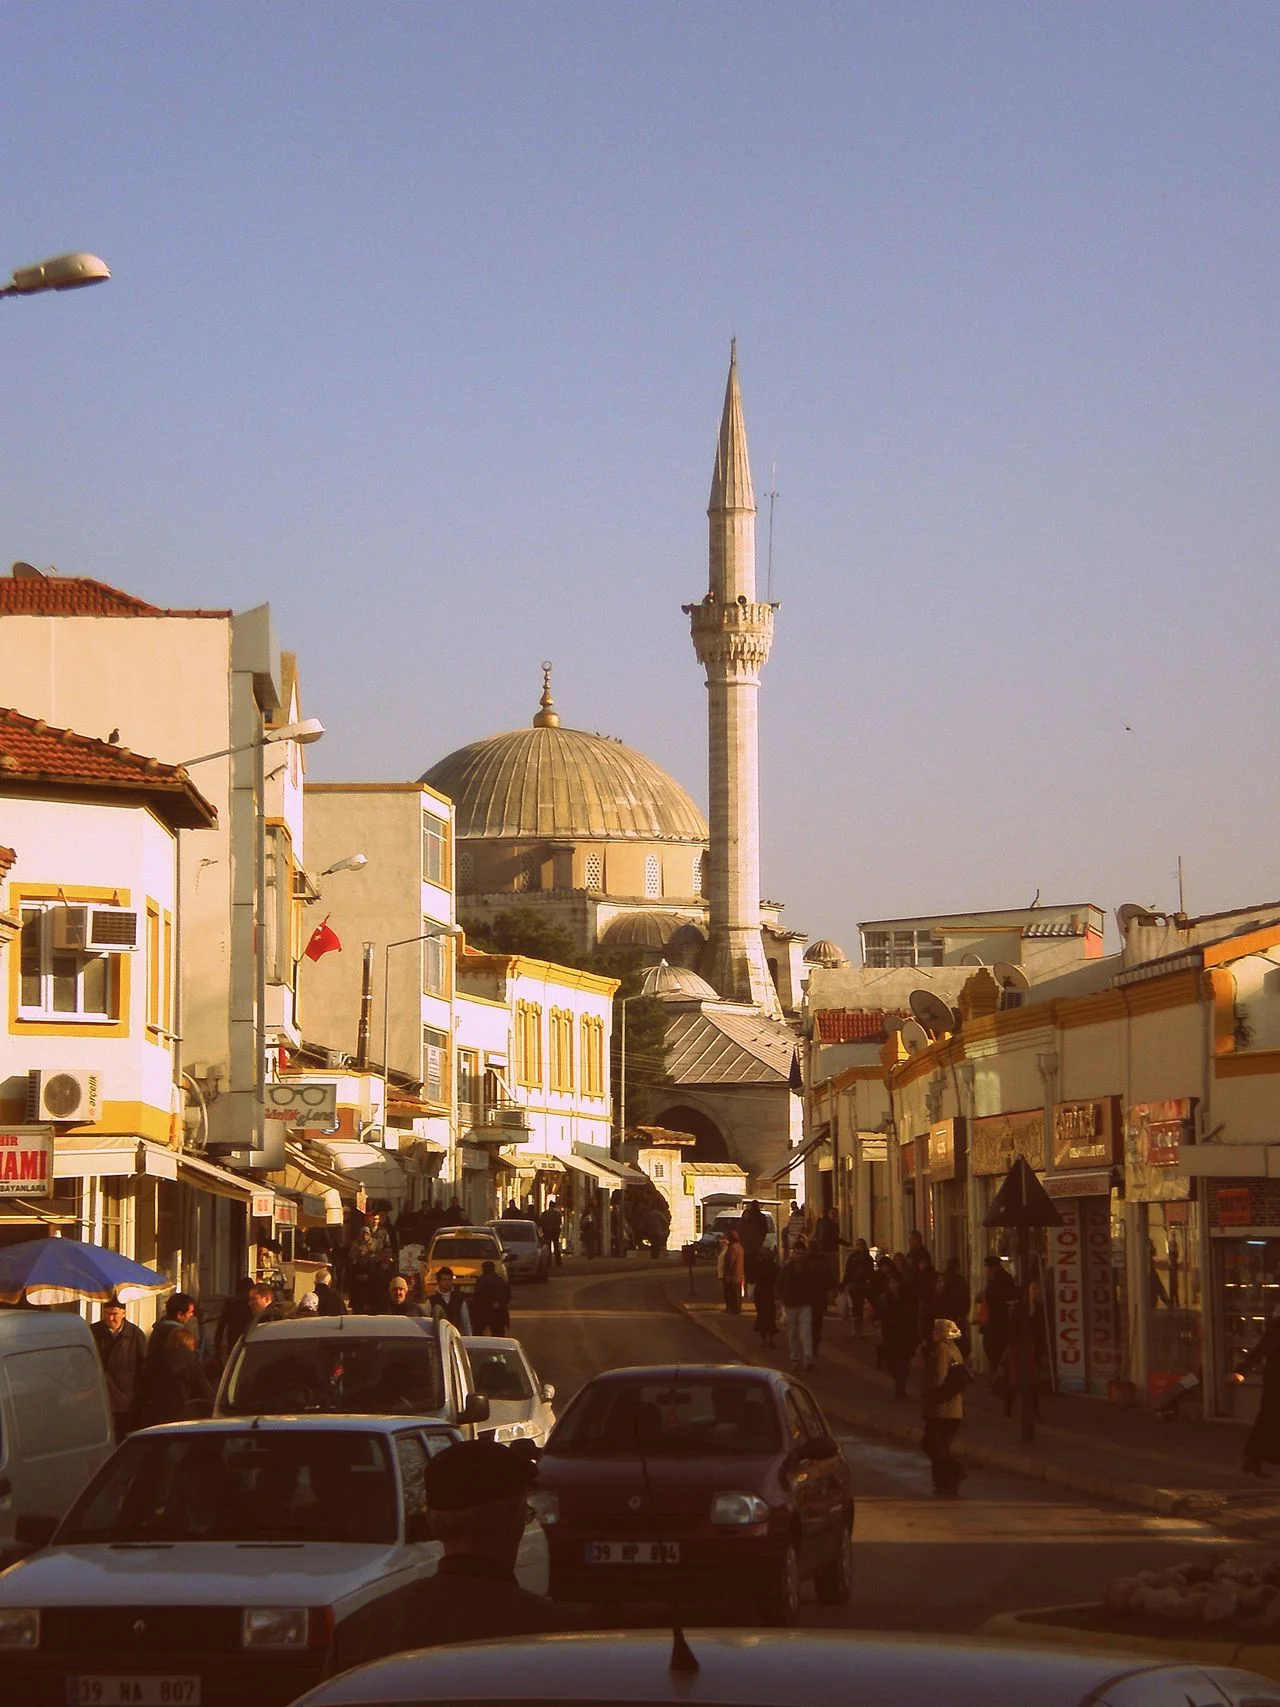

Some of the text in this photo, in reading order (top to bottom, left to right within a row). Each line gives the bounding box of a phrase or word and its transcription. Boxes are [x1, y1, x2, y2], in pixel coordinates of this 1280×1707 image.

[87, 1076, 98, 1107] arçelik
[0, 1150, 48, 1180] AMI
[1056, 1212, 1081, 1365] GÖZLÜKÇÜ
[594, 1544, 611, 1561] 39
[80, 1680, 195, 1702] 39 NA 807
